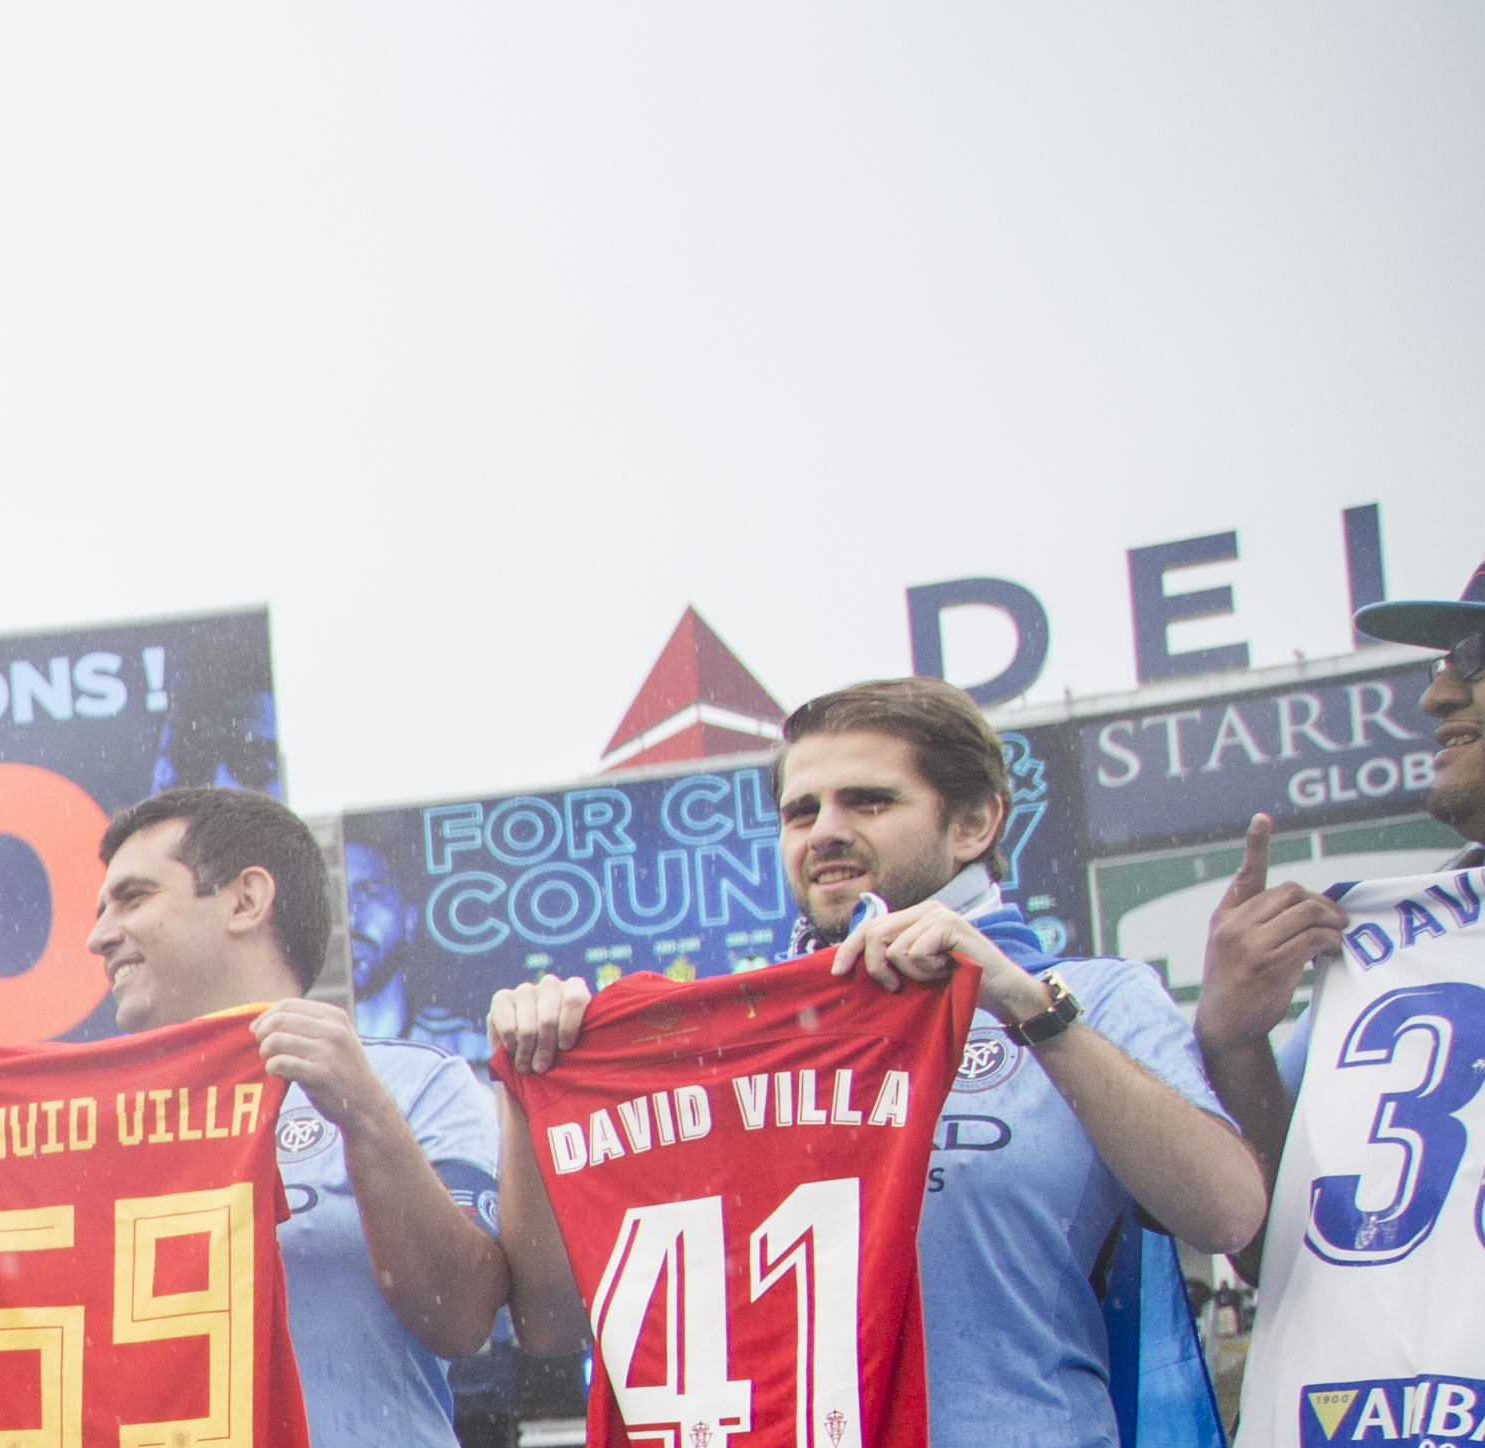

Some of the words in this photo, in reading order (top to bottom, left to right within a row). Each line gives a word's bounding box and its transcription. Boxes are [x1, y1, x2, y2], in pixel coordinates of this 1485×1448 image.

[1096, 681, 1424, 788] STARR
[1288, 752, 1436, 807] GLOB
[424, 788, 636, 874] FOR
[660, 768, 780, 846] CL
[426, 836, 788, 955] COUN
[1341, 868, 1485, 973] DAV
[114, 1082, 264, 1147] VILLA
[546, 1085, 712, 1175] DAVID
[732, 1068, 909, 1130] VILLA
